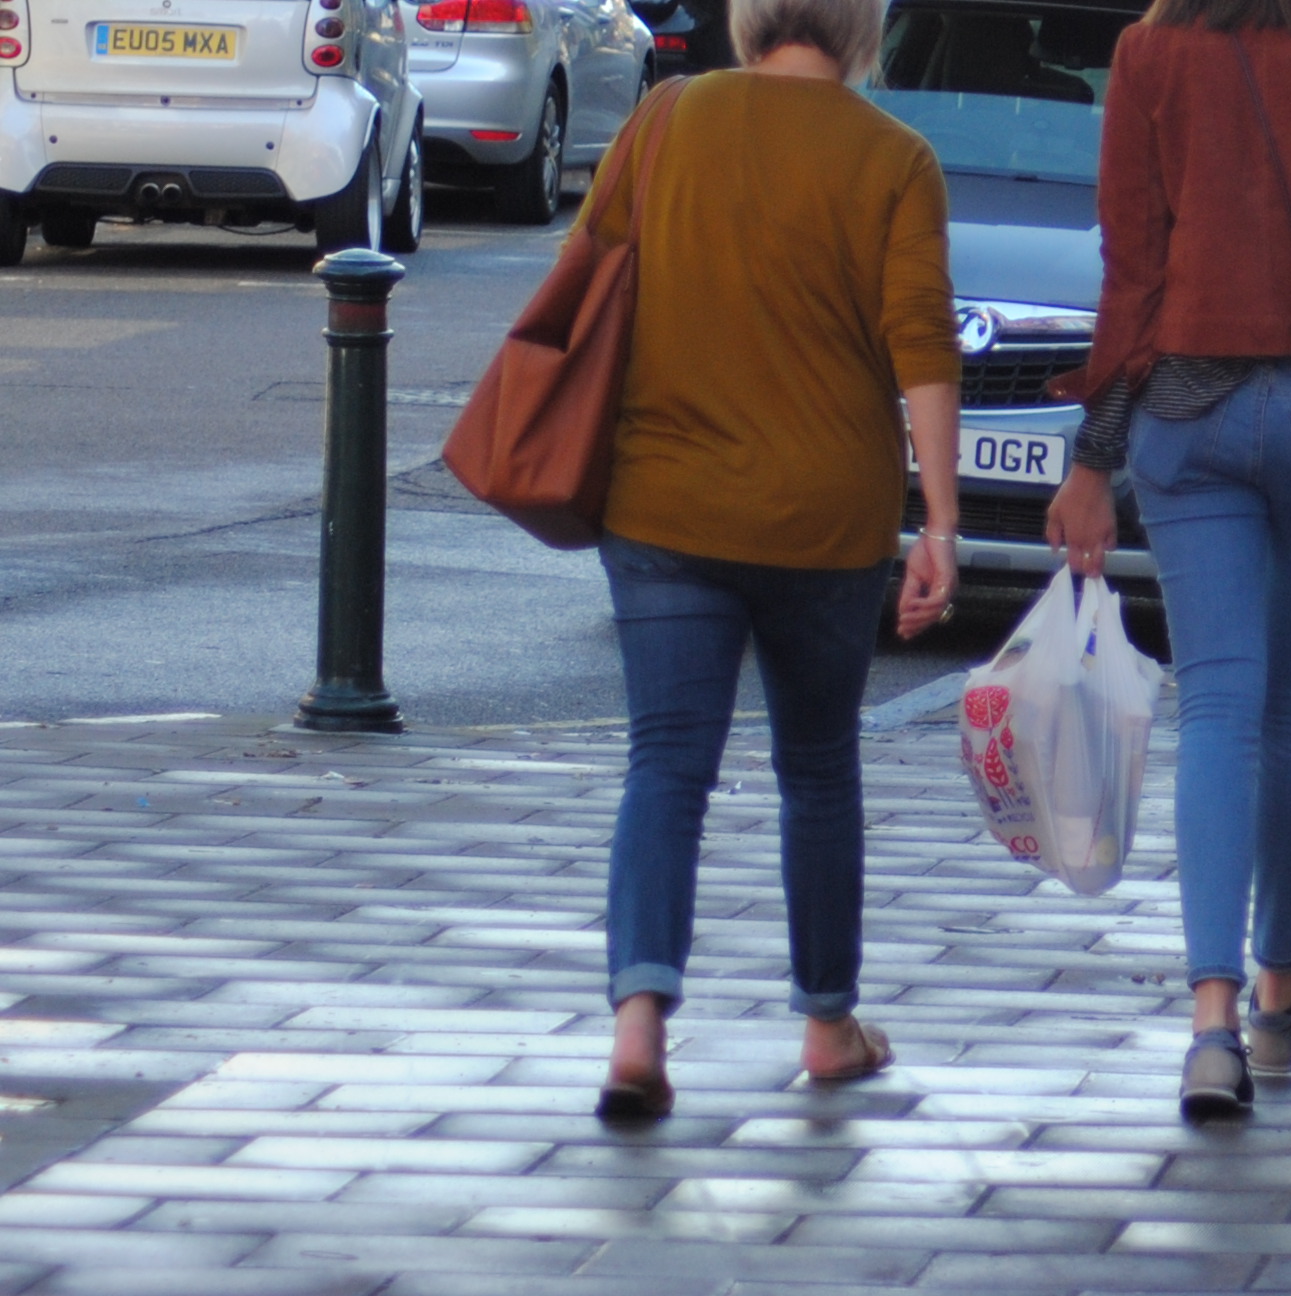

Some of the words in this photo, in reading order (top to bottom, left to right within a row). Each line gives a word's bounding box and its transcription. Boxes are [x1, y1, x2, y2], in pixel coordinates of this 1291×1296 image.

[112, 29, 176, 52] EU05
[183, 32, 229, 54] MXA
[974, 436, 1049, 475] OGR
